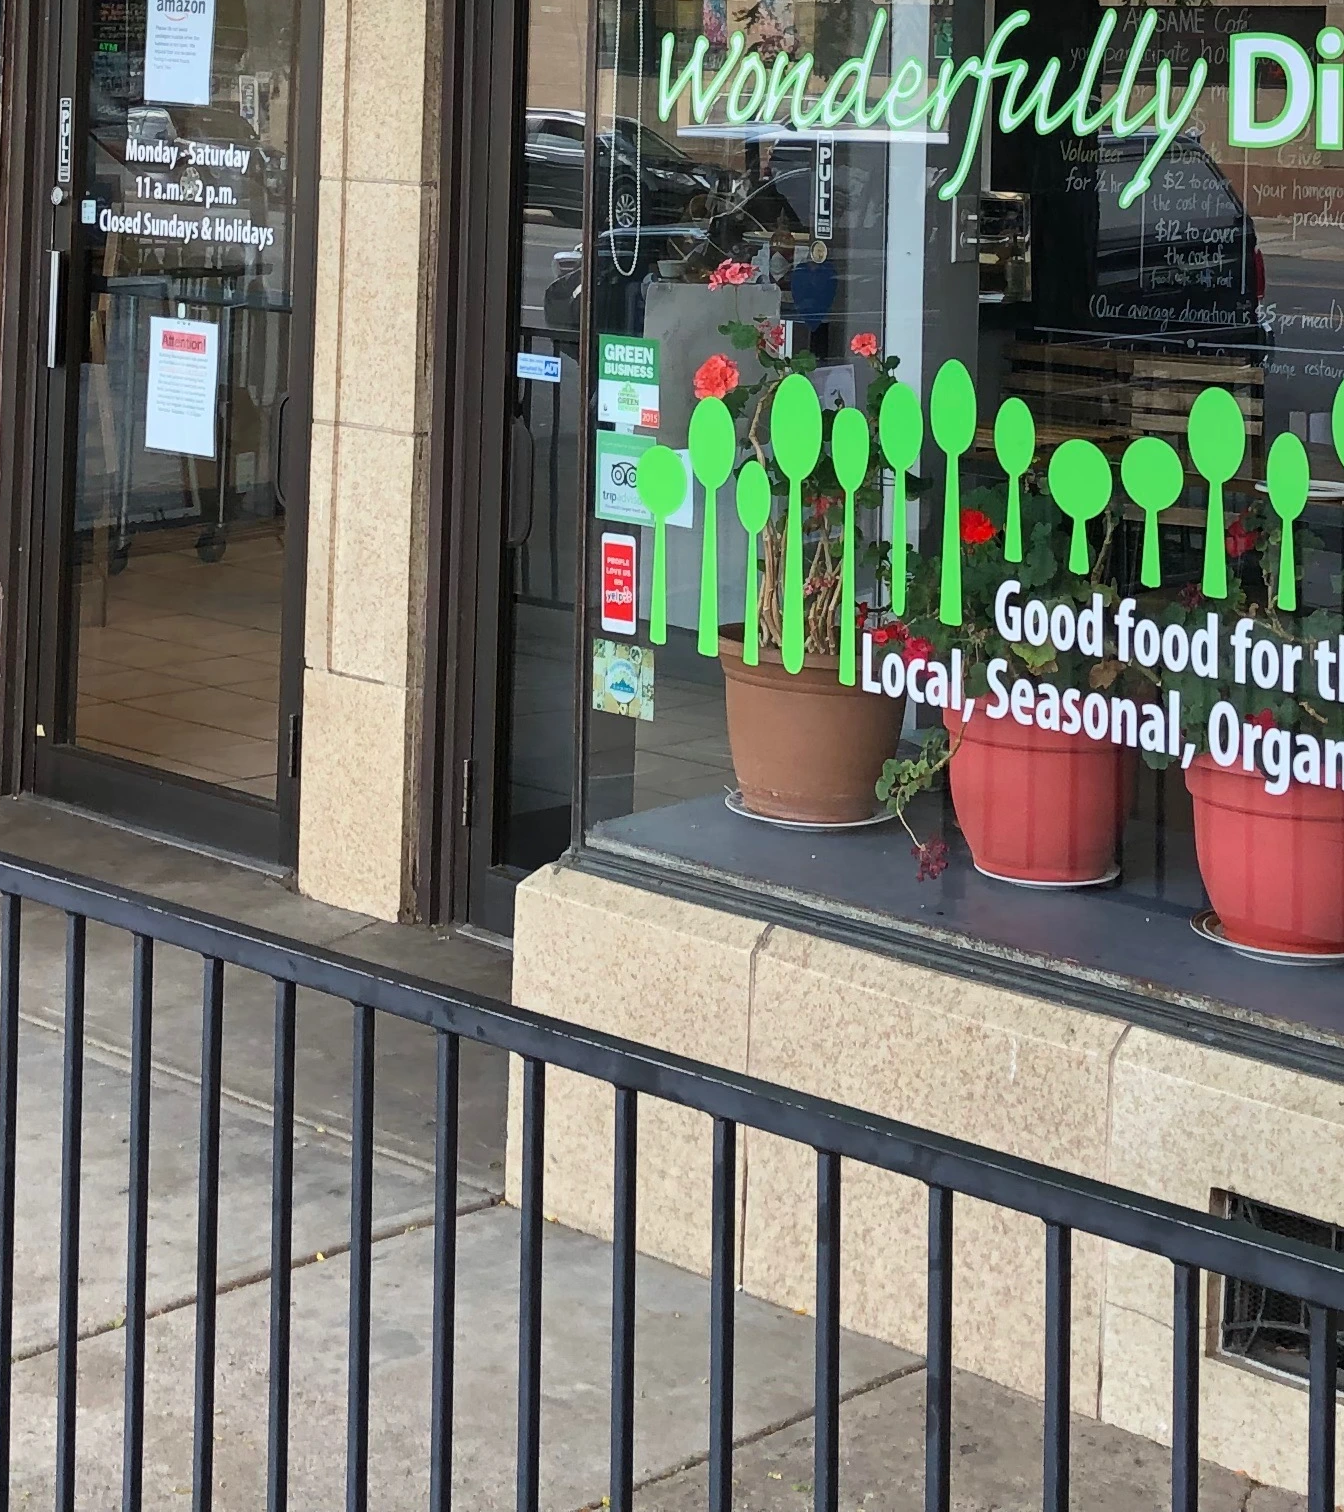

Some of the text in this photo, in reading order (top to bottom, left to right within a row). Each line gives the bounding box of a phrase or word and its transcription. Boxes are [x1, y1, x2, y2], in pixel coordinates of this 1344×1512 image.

[1155, 8, 1205, 34] SAME
[657, 7, 1208, 210] Wonderfully
[61, 109, 71, 164] PULL
[126, 138, 251, 175] Monday Saturday
[1059, 139, 1124, 164] Volunteer
[1277, 142, 1323, 168] Give
[135, 176, 237, 208] 11 a.m. 2 p.m.
[818, 146, 833, 216] PULL
[1065, 170, 1123, 194] for hr
[1163, 170, 1234, 192] $2 to cover
[1252, 184, 1286, 204] your
[1152, 193, 1214, 218] the cost of
[99, 209, 274, 251] Closed Sundays & Holidays
[1155, 217, 1241, 245] $12 to cover
[1163, 244, 1226, 273] the cost of
[1089, 293, 1344, 335] (Our average donation is $5 per meal)
[163, 334, 206, 354] Attention!
[604, 343, 654, 365] GREEN
[604, 361, 654, 379] BUSINESS
[641, 412, 658, 424] 2015
[606, 566, 623, 577] LOVE
[607, 556, 630, 567] PEOPLE
[606, 590, 625, 604] yelp
[994, 579, 1104, 659] Good
[1115, 598, 1219, 680] food
[1230, 617, 1304, 691] for
[861, 632, 976, 723] Local,
[986, 658, 1197, 770] Seasonal,
